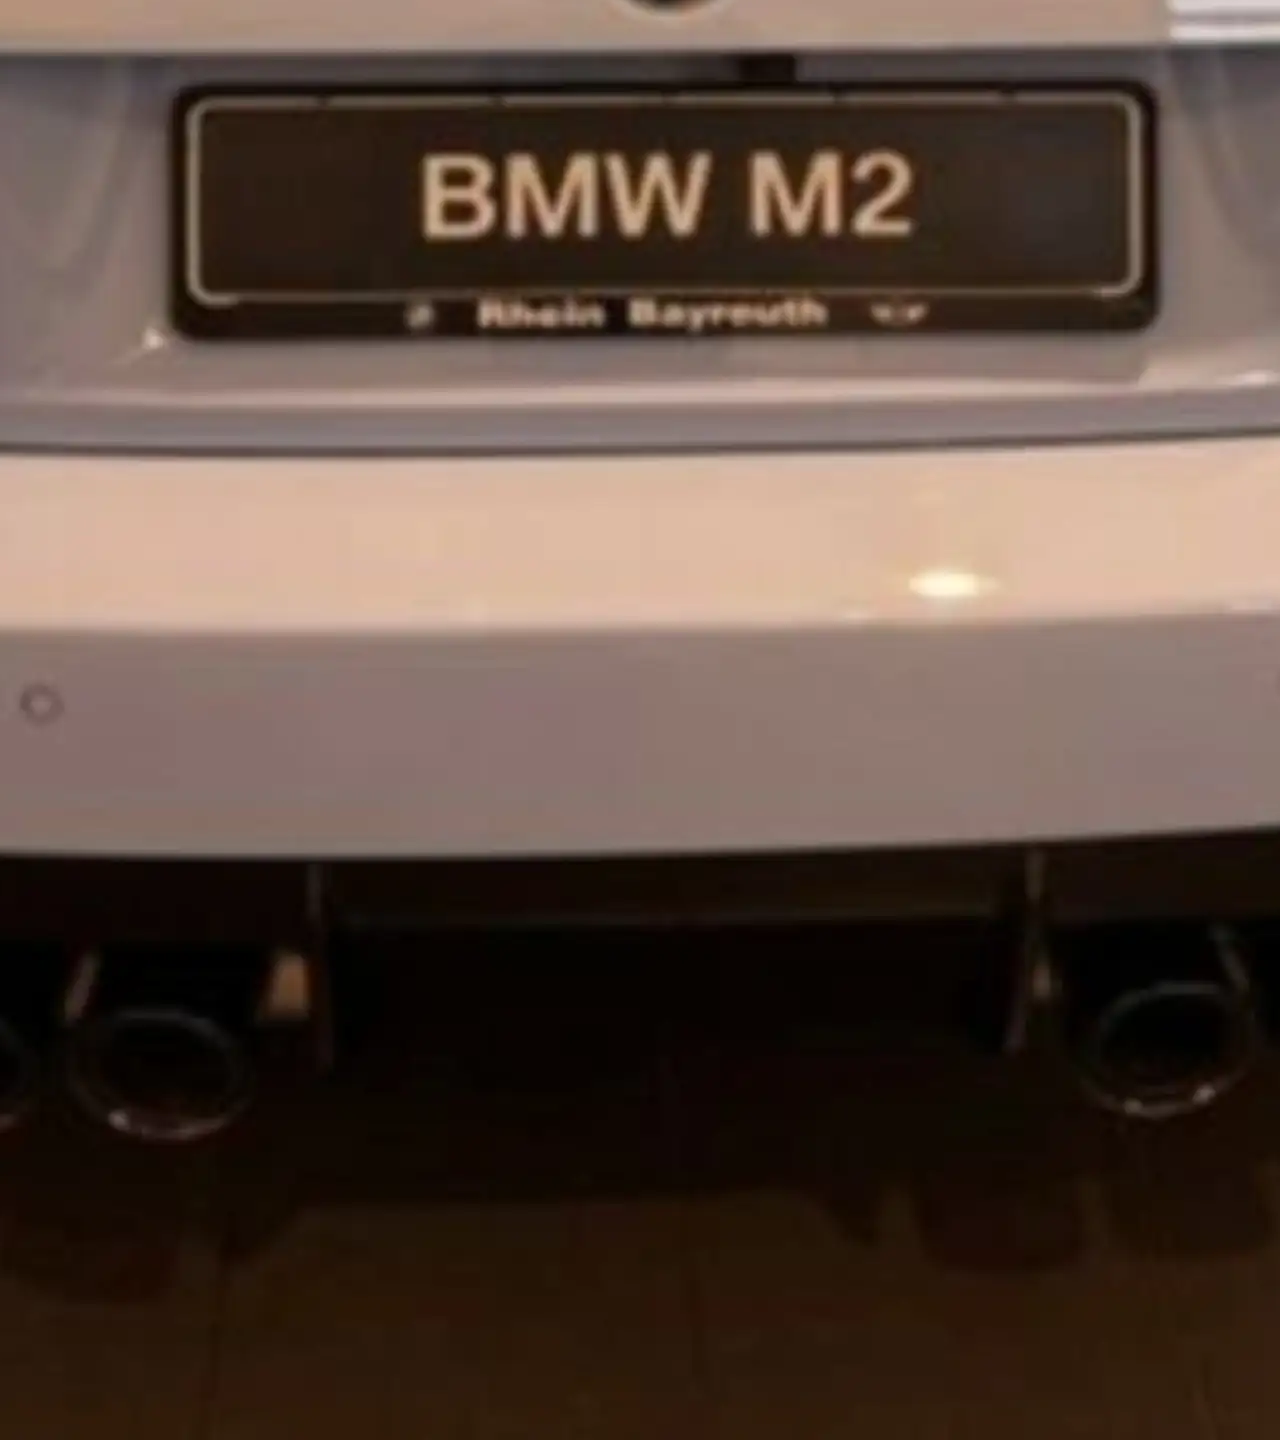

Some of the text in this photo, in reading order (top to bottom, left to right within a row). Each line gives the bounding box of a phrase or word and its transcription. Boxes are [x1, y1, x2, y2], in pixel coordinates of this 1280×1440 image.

[423, 150, 914, 239] BMW M2
[478, 297, 829, 333] Rhein Bayreuth
